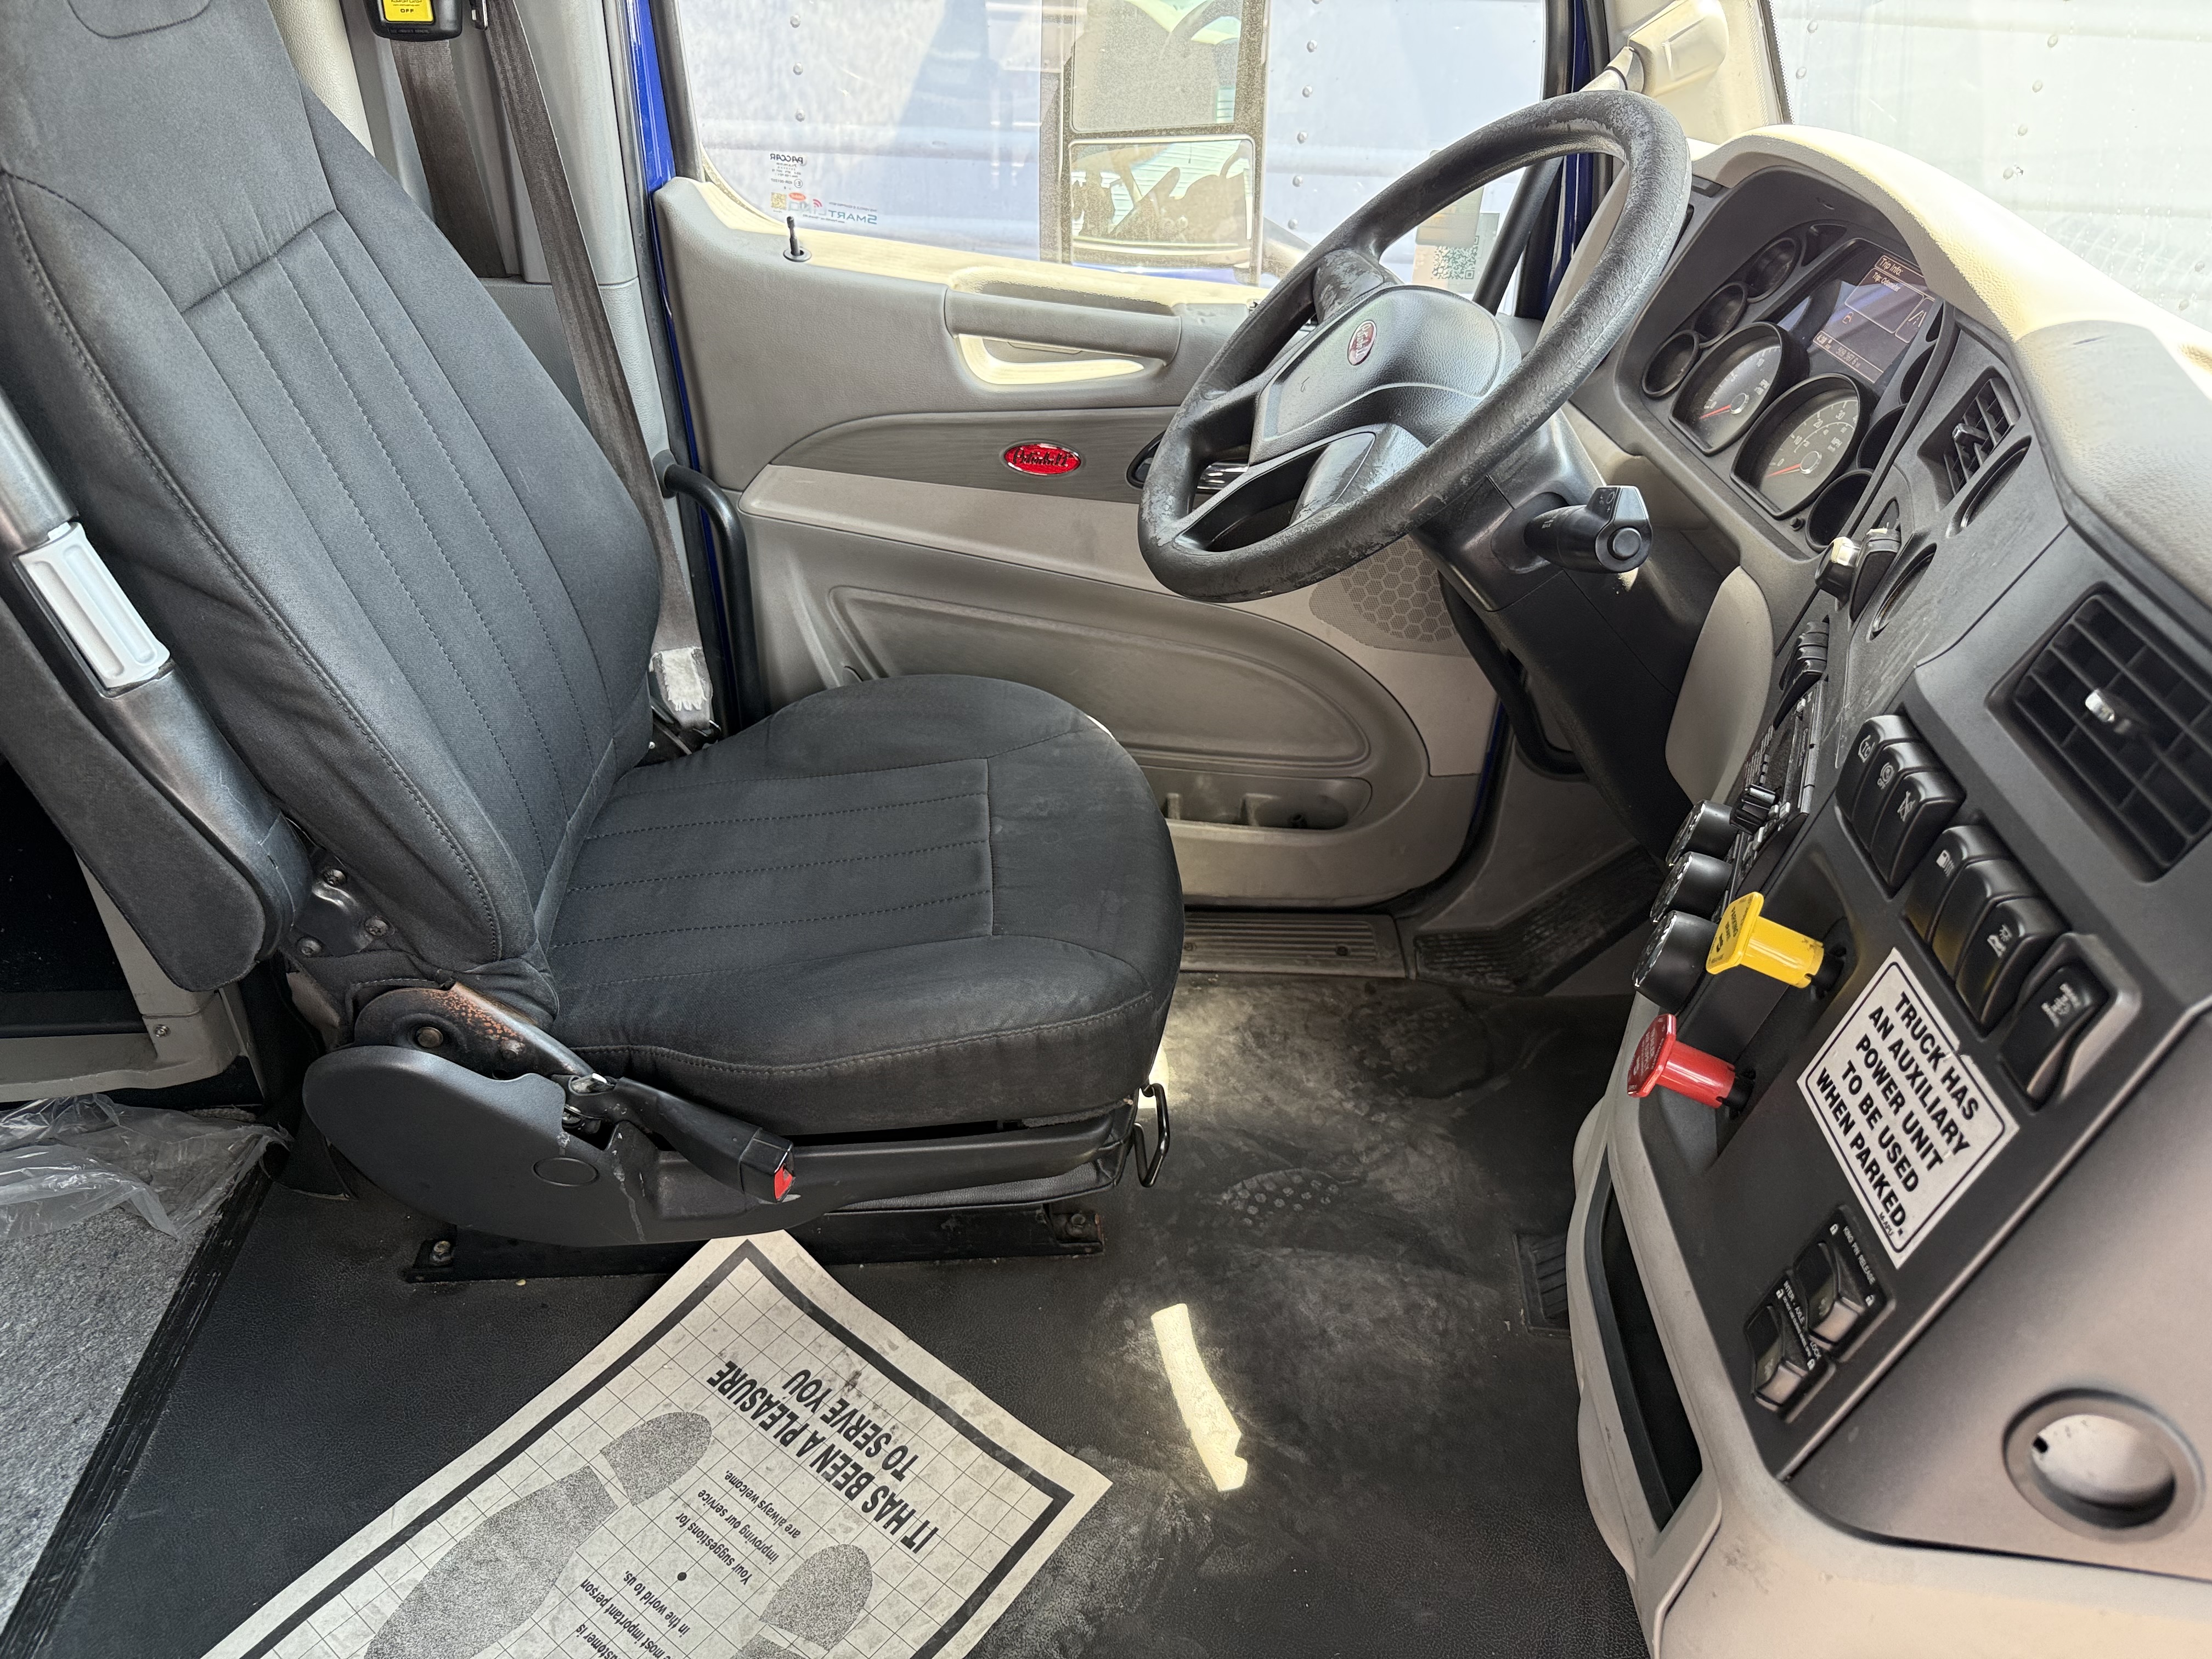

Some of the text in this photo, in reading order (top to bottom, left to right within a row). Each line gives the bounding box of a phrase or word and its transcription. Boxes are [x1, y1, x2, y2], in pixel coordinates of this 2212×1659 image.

[1880, 258, 1904, 276] Trip Info:
[1813, 419, 1824, 428] 20
[1835, 410, 1846, 420] 30
[1793, 436, 1802, 445] 10
[1777, 458, 1785, 466] 0
[1894, 991, 1979, 1120] TRUCK HAS
[1868, 1006, 1971, 1156] AN AUXILIARY
[1855, 1033, 1944, 1171] POWER UNIT
[1842, 1059, 1918, 1192] TO BE USED
[1816, 1066, 1906, 1237] WHEN PARKED.
[1843, 1226, 1876, 1285] KING PIN RELEASE
[1795, 1306, 1805, 1324] AXLE
[1810, 1342, 1821, 1360] LOCK
[782, 1369, 919, 1482] TO SERVE YOU
[706, 1360, 940, 1554] IT HAS BEEN A PLEASURE
[697, 1489, 780, 1565] improving our service
[757, 1499, 787, 1527] always
[784, 1523, 802, 1539] are
[675, 1513, 753, 1585] Your suggestions for
[634, 1583, 646, 1596] to
[639, 1590, 668, 1615] world
[575, 1623, 588, 1638] is
[580, 1579, 665, 1659] most important person
[664, 1611, 681, 1629] the
[678, 1623, 691, 1638] in
